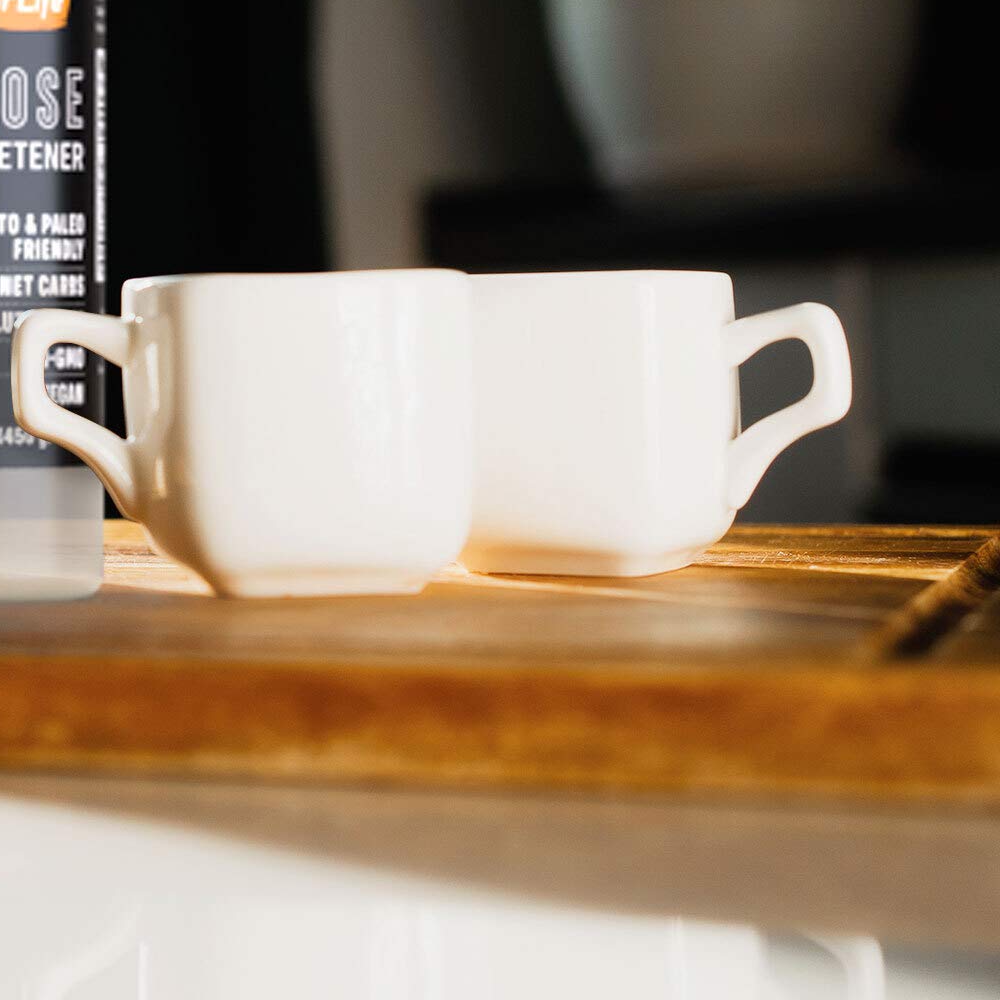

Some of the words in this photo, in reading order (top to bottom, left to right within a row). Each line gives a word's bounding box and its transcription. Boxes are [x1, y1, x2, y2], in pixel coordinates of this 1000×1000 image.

[24, 212, 37, 236] &
[41, 212, 85, 236] PALEO
[13, 237, 85, 261] FRIENDLY
[38, 273, 85, 297] CARBS
